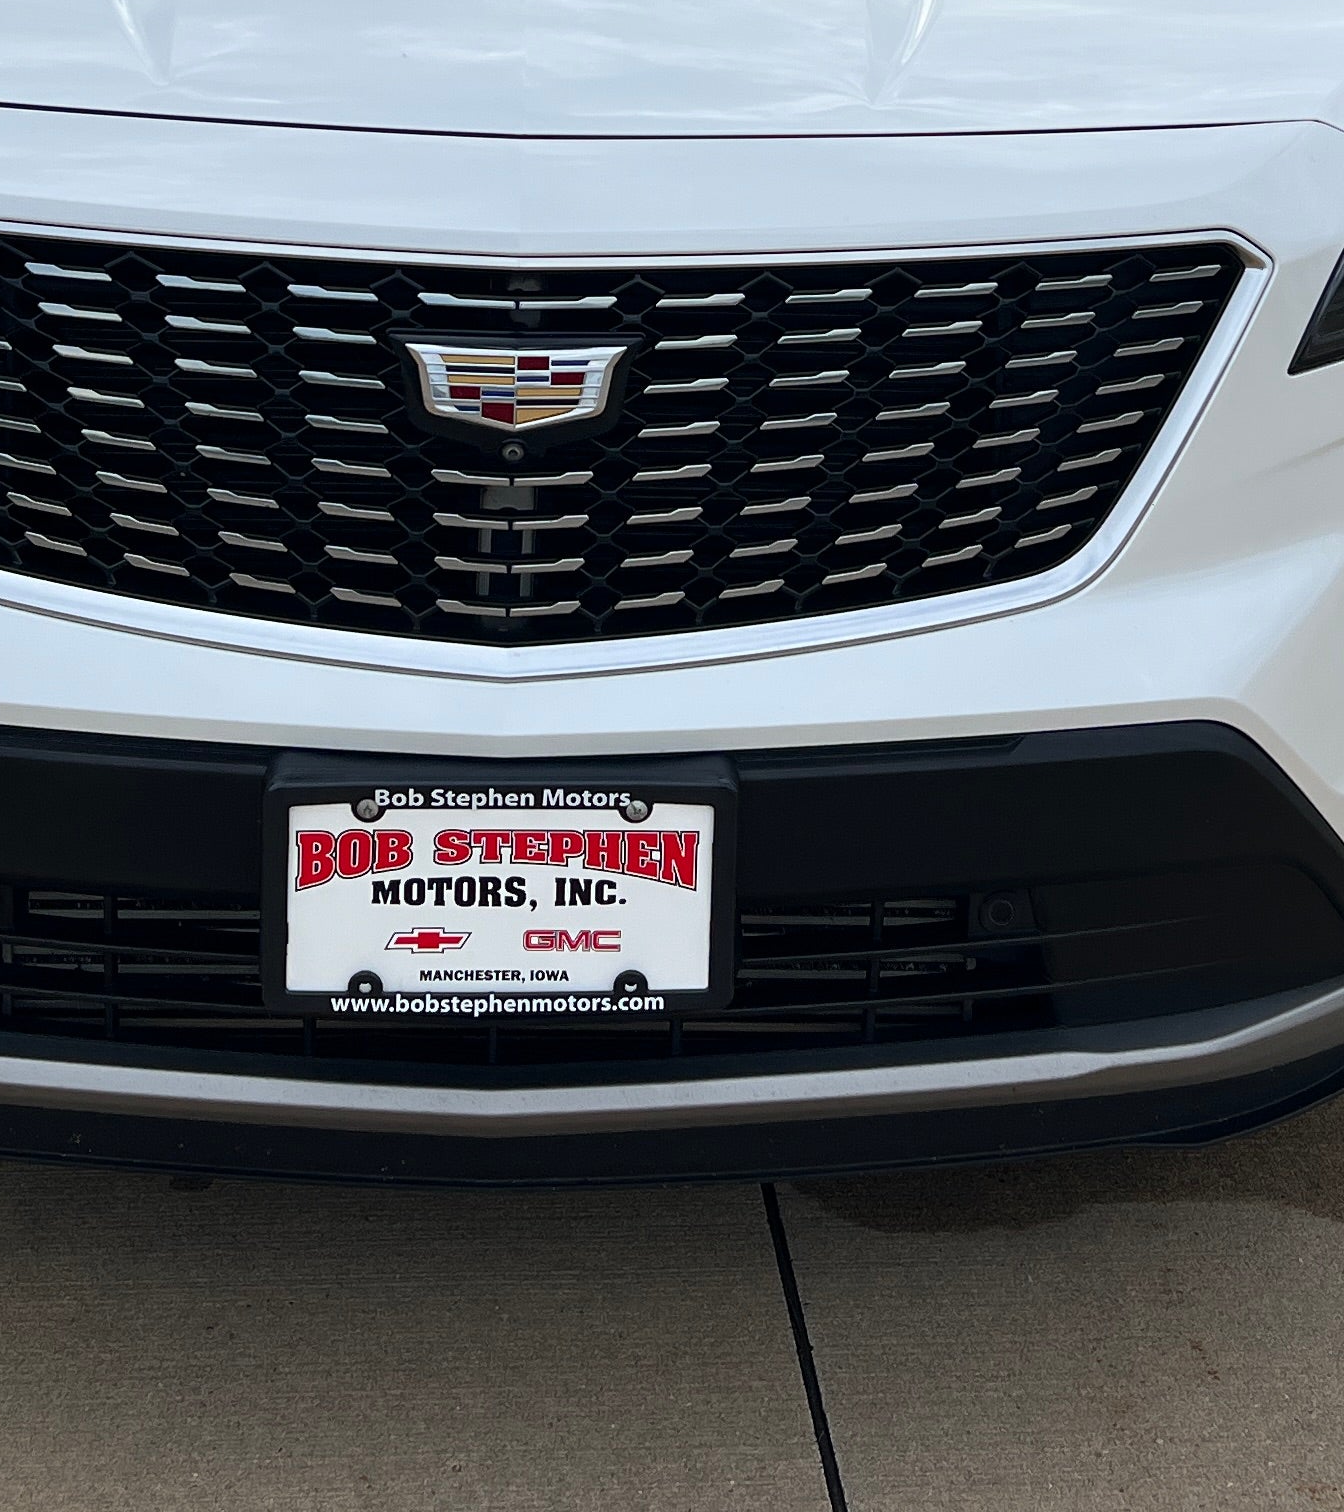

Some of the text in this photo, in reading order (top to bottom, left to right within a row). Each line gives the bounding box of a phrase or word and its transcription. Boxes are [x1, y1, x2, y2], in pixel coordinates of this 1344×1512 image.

[374, 789, 631, 811] Bob Stephen Motors
[295, 829, 700, 892] BOB STEPHEN
[371, 876, 627, 912] MOTORS, INC.
[522, 929, 621, 952] GMC
[419, 969, 569, 983] MANCHESTER, IOWA
[331, 993, 665, 1017] www.bobstephenmotors.com
